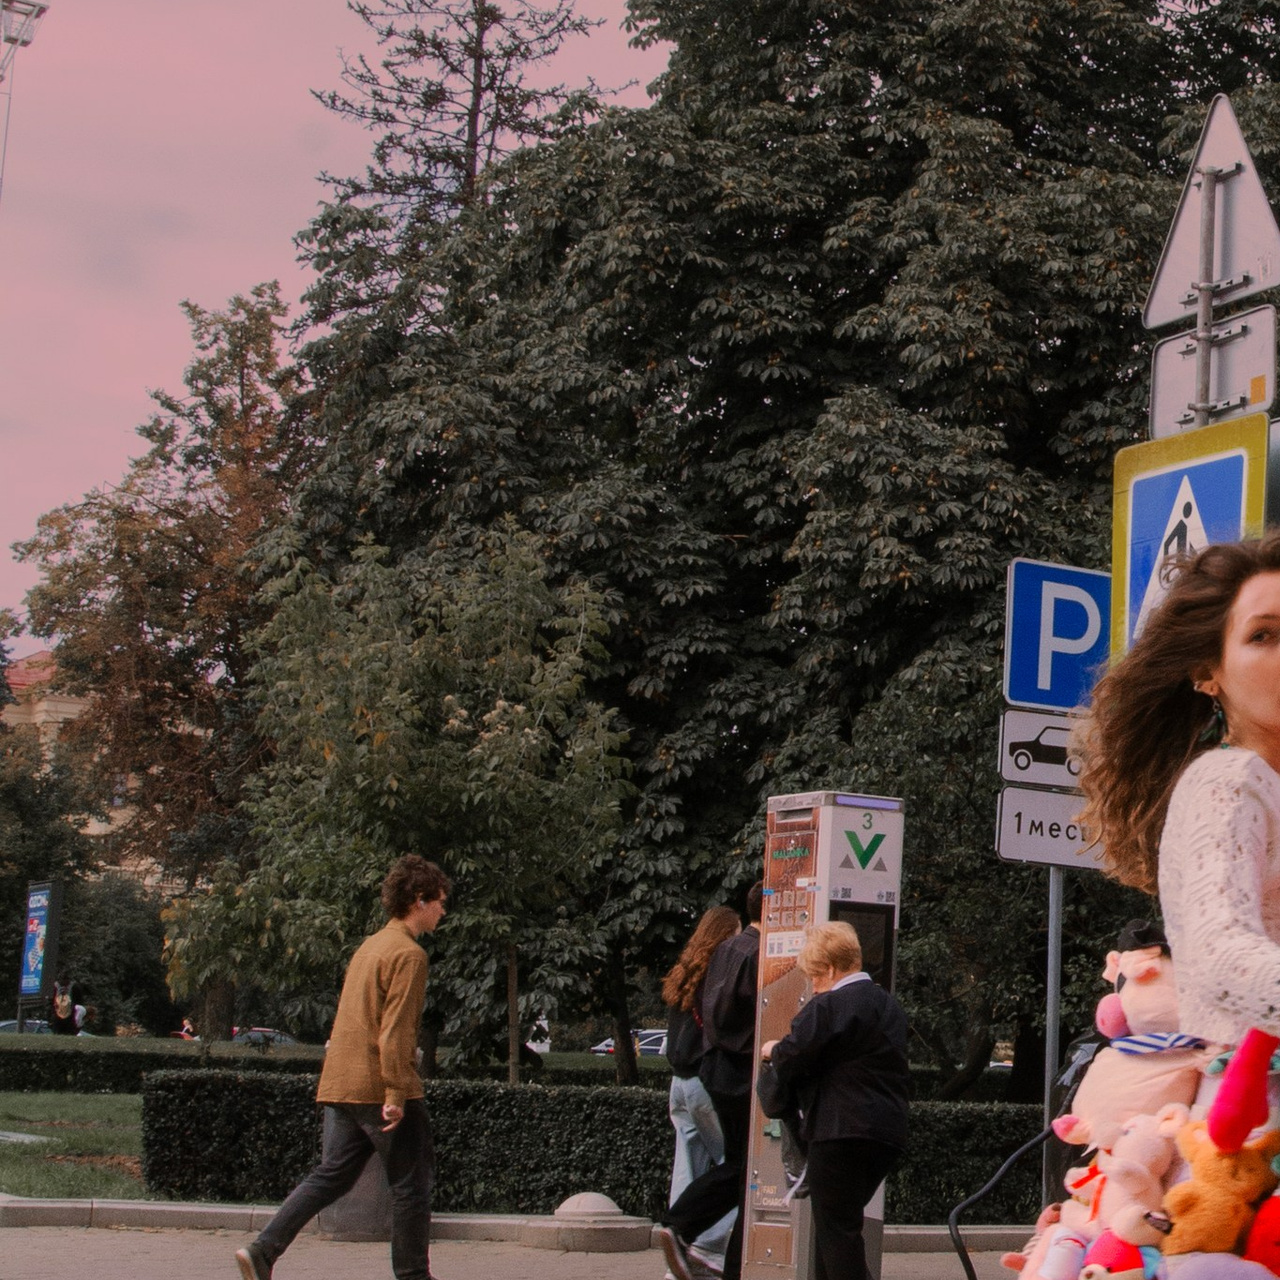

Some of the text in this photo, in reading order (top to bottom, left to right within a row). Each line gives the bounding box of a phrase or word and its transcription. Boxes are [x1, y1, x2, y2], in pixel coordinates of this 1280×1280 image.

[1037, 580, 1102, 690] P
[862, 813, 873, 829] 3
[1014, 811, 1023, 834] 1
